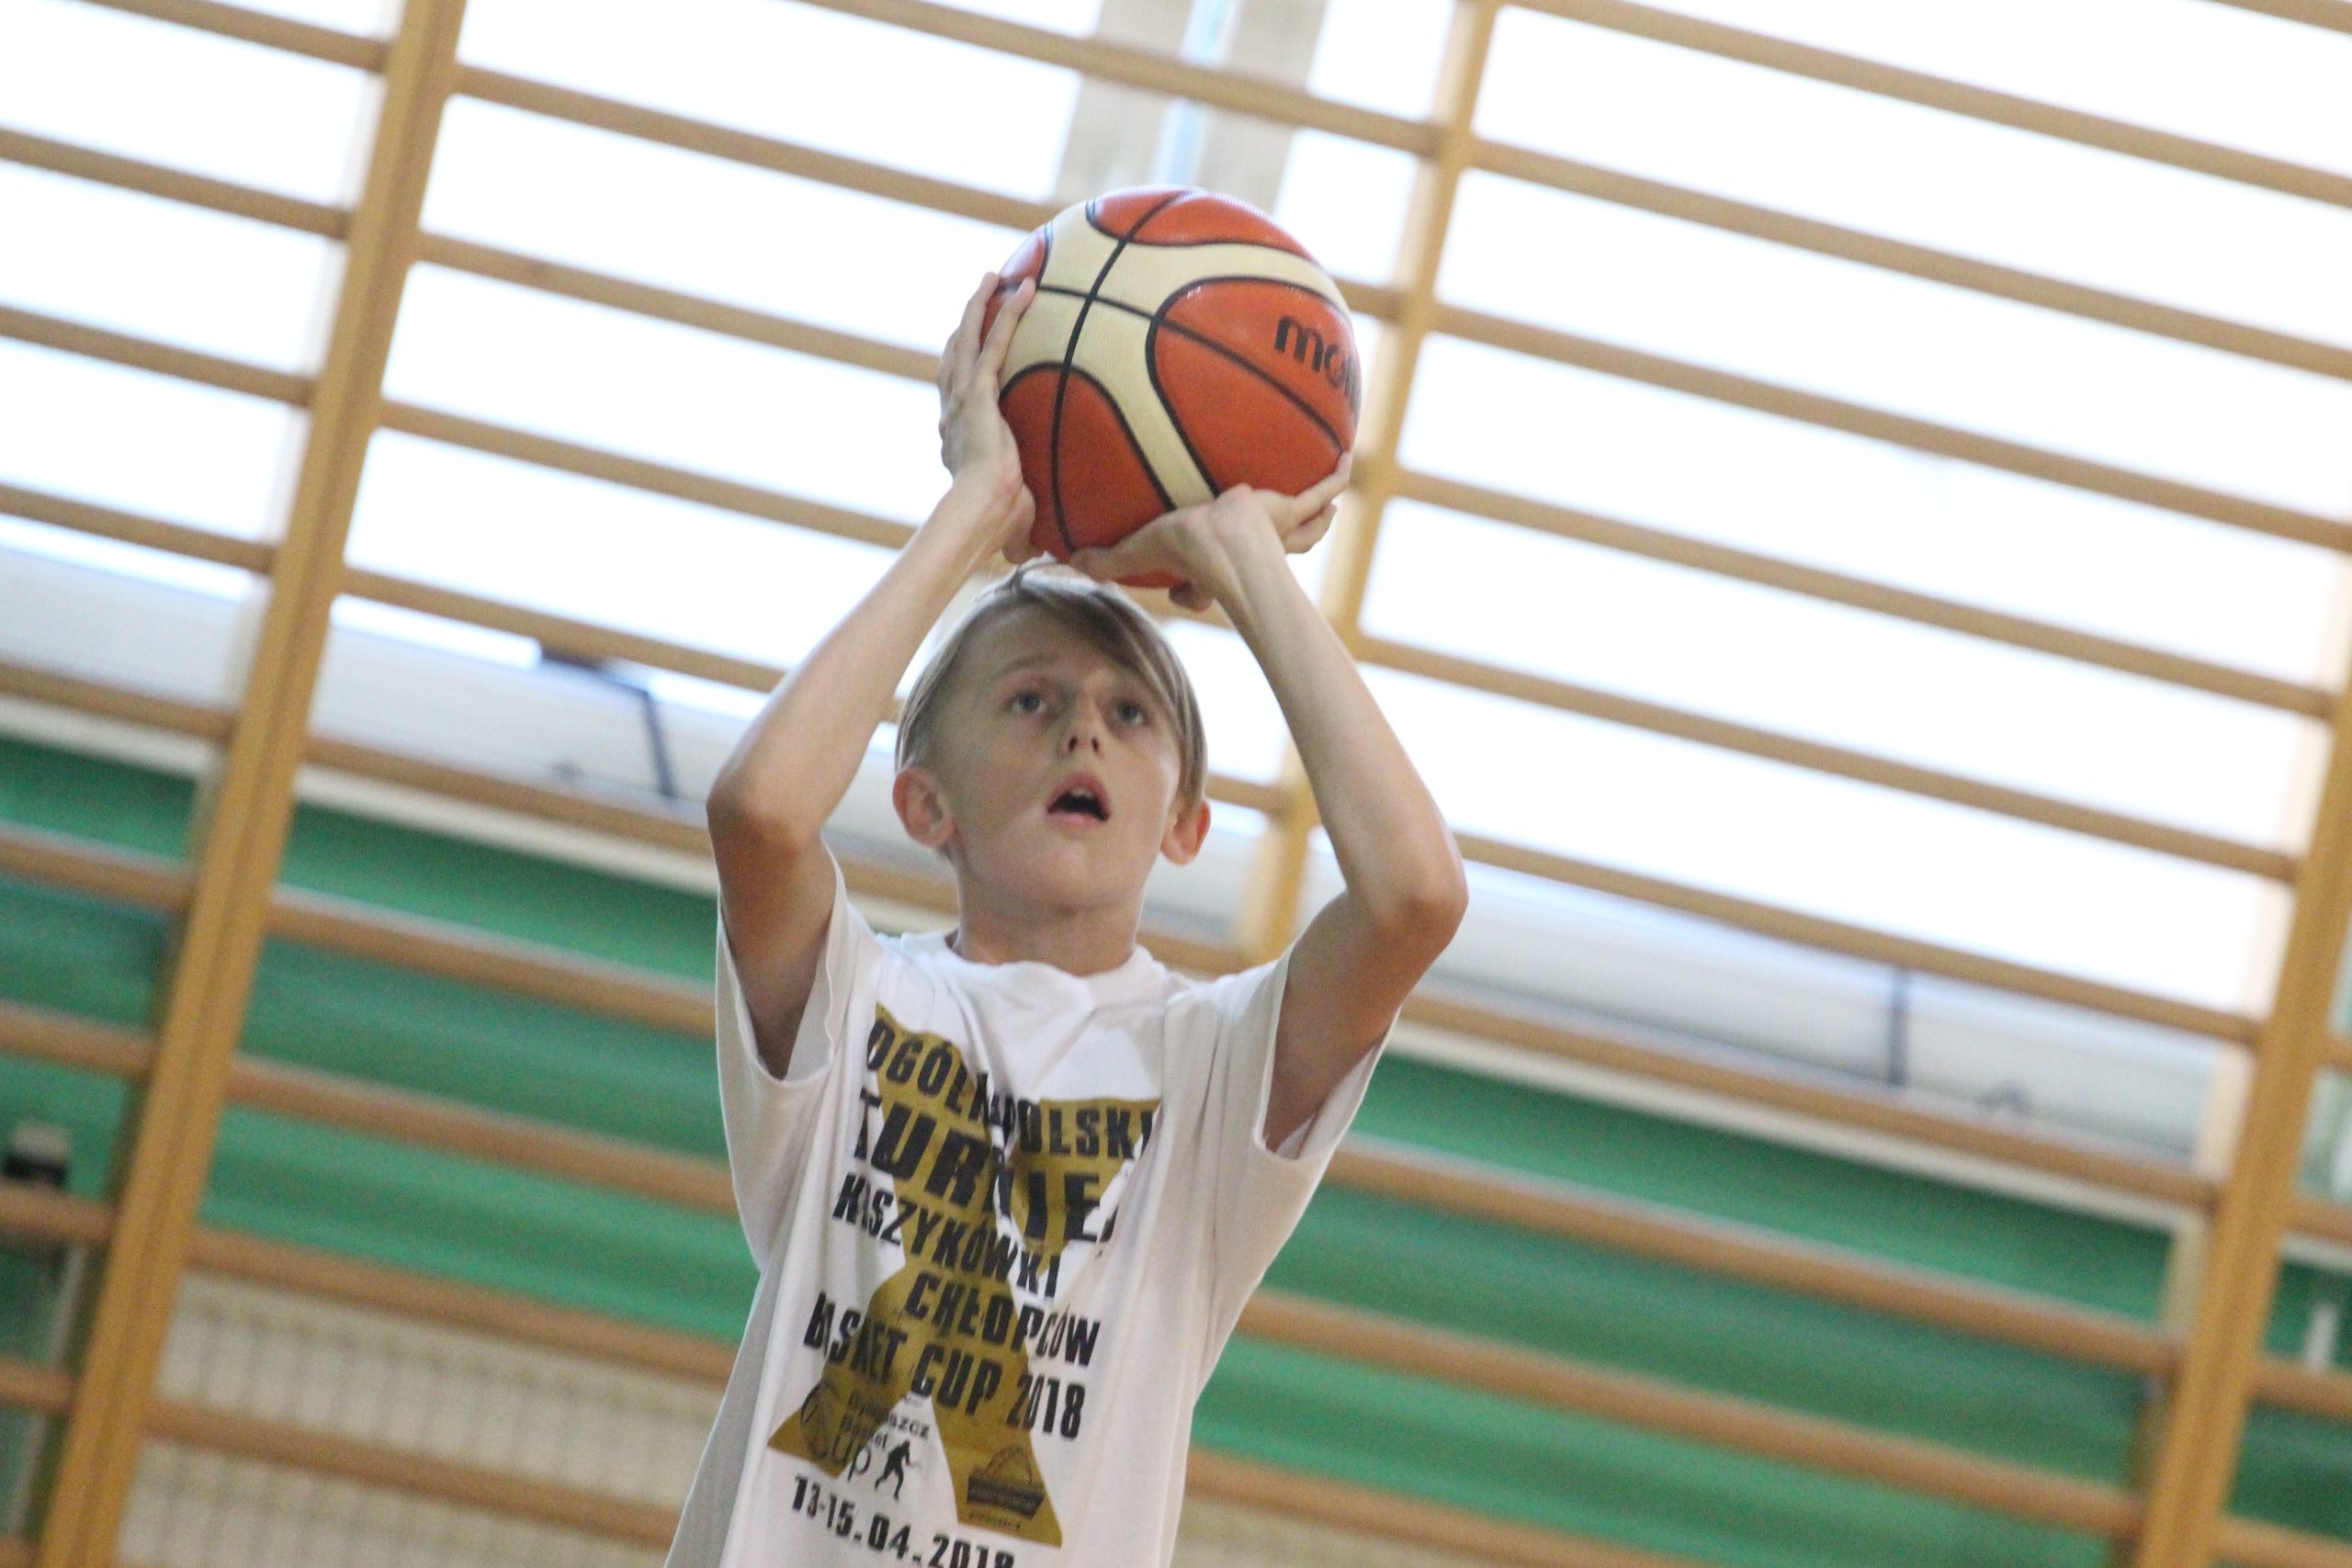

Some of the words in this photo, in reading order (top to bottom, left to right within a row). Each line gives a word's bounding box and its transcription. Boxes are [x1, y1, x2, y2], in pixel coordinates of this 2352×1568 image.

[854, 1087, 1118, 1243] TURNIE
[832, 1172, 1060, 1298] KSZYKÓWKI
[910, 1344, 1003, 1416] CUP
[1006, 1373, 1085, 1439] 2018
